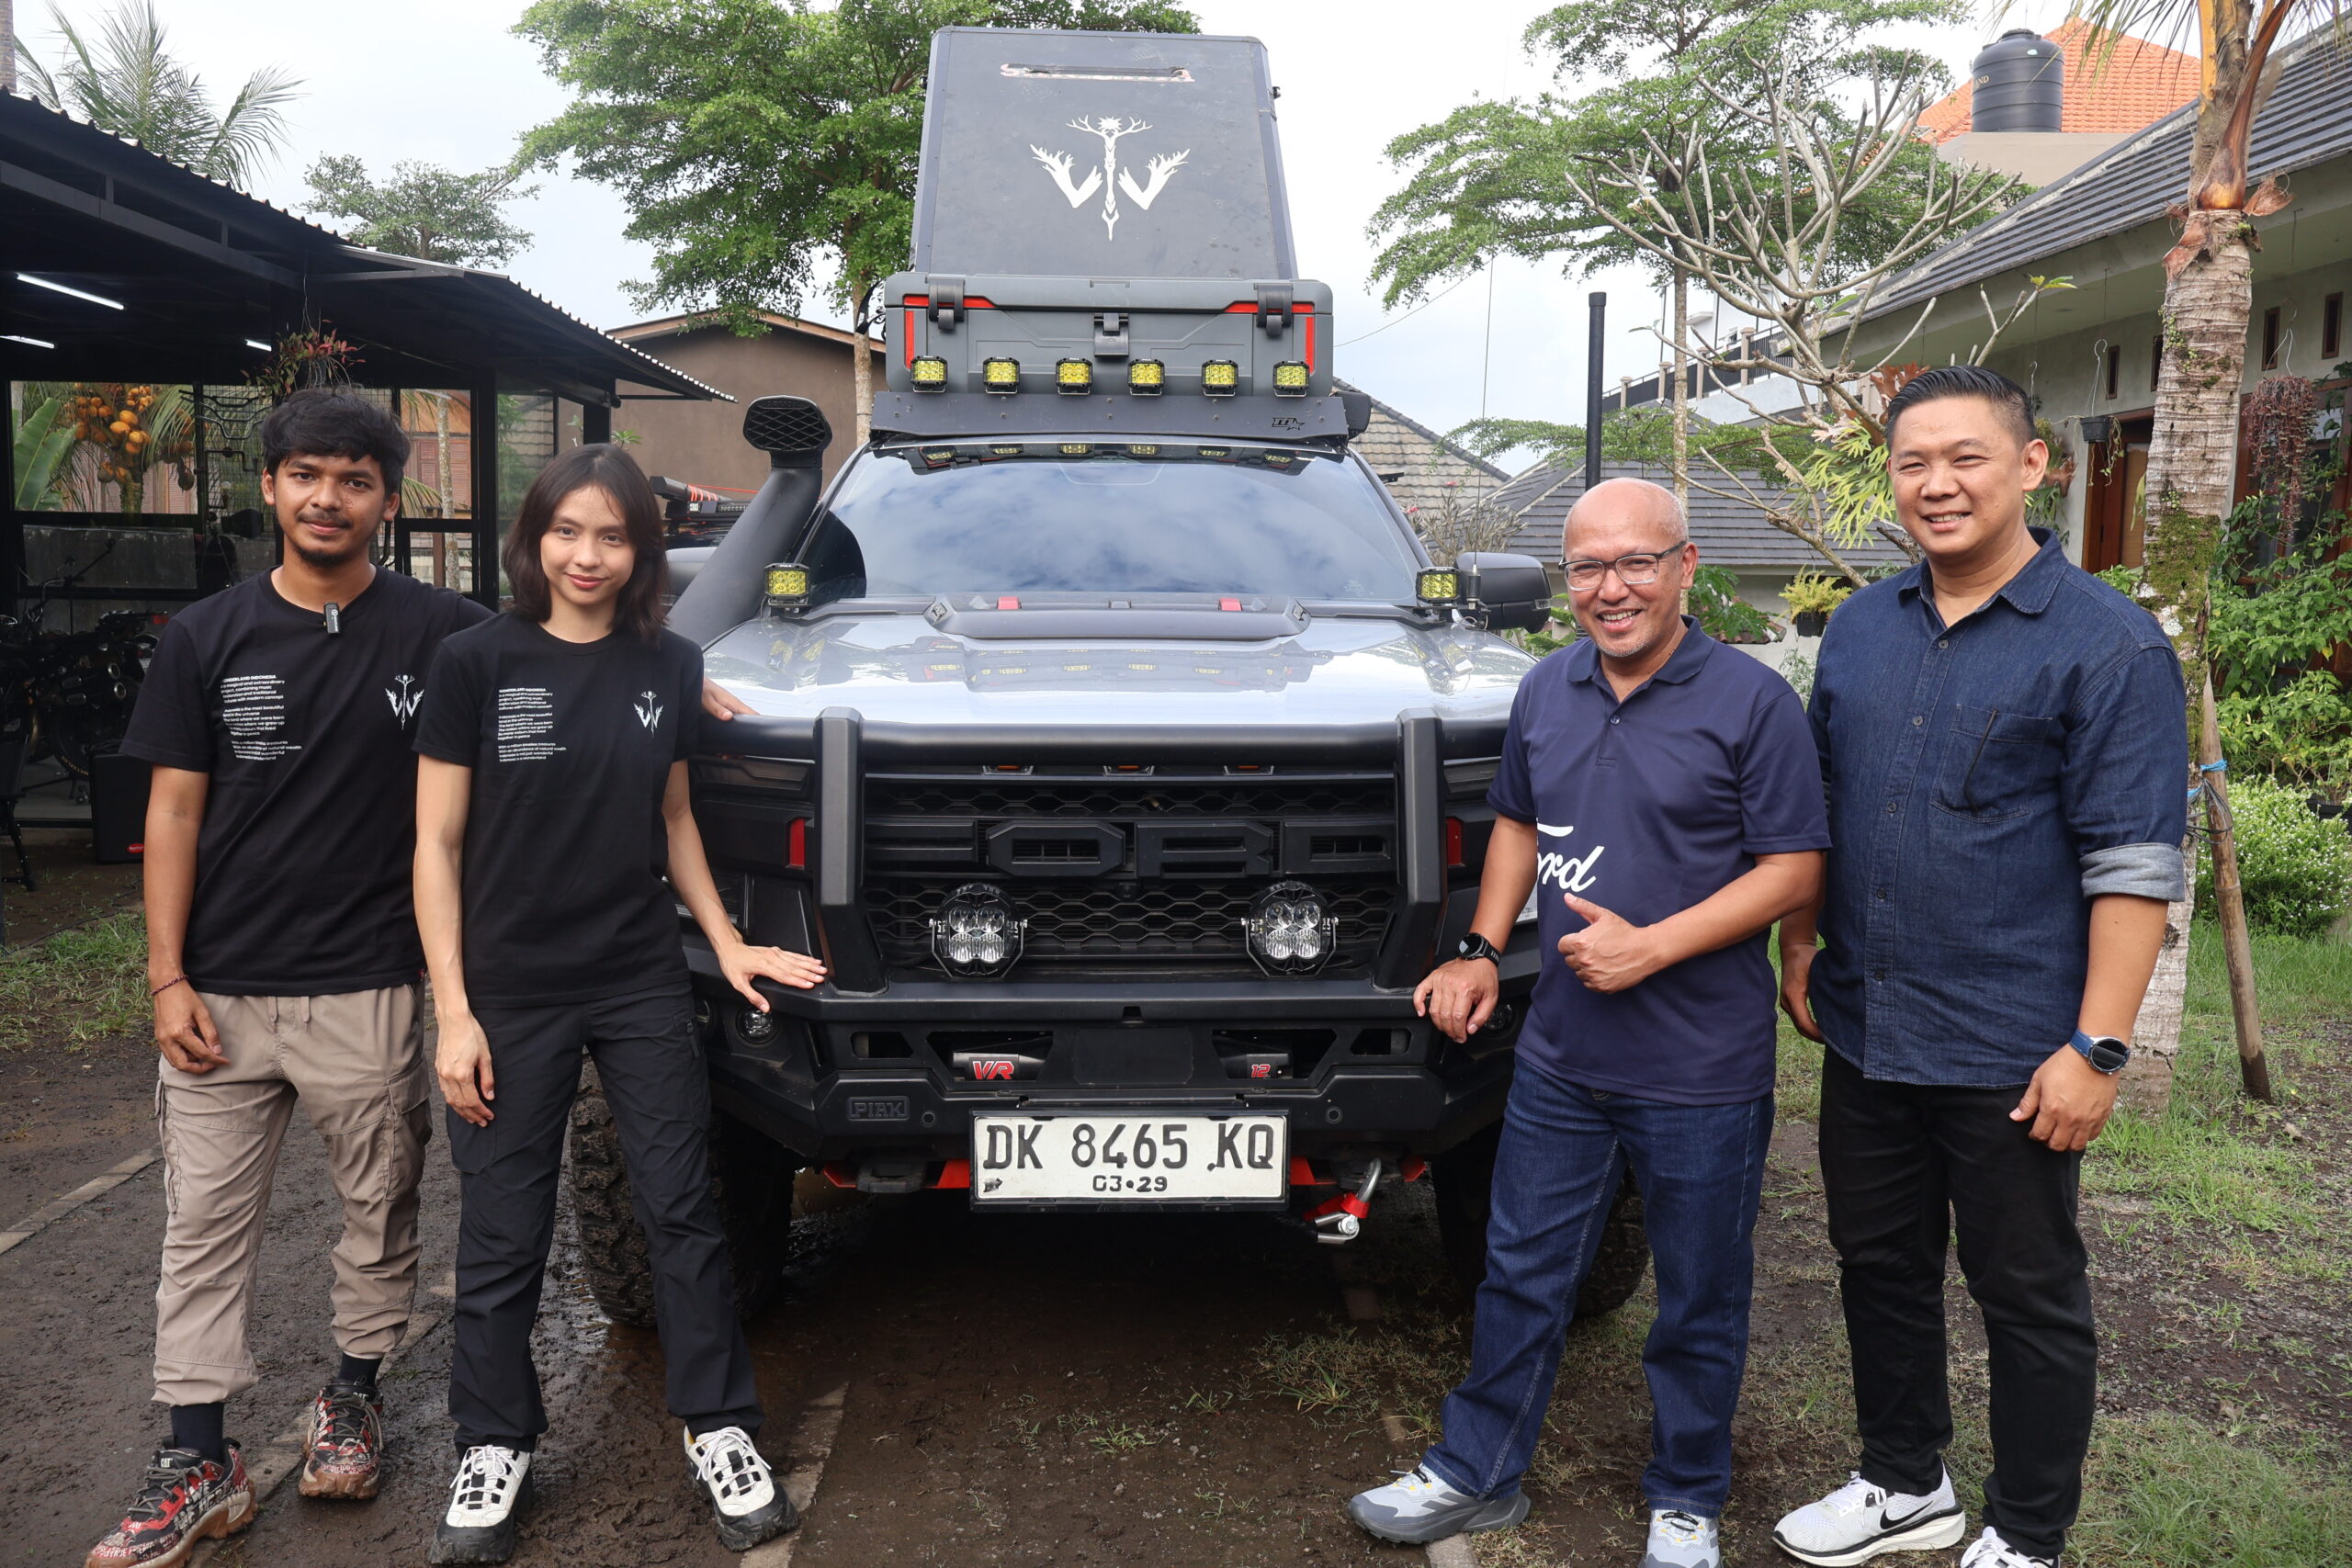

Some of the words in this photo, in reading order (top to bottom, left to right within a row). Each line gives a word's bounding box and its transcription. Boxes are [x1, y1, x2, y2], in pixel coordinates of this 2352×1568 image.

[973, 1060, 1014, 1080] VR
[1250, 1064, 1271, 1078] 12
[851, 1101, 905, 1118] PIAK
[982, 1123, 1043, 1169] DK
[1071, 1123, 1188, 1169] 8465
[1216, 1122, 1274, 1169] KQ
